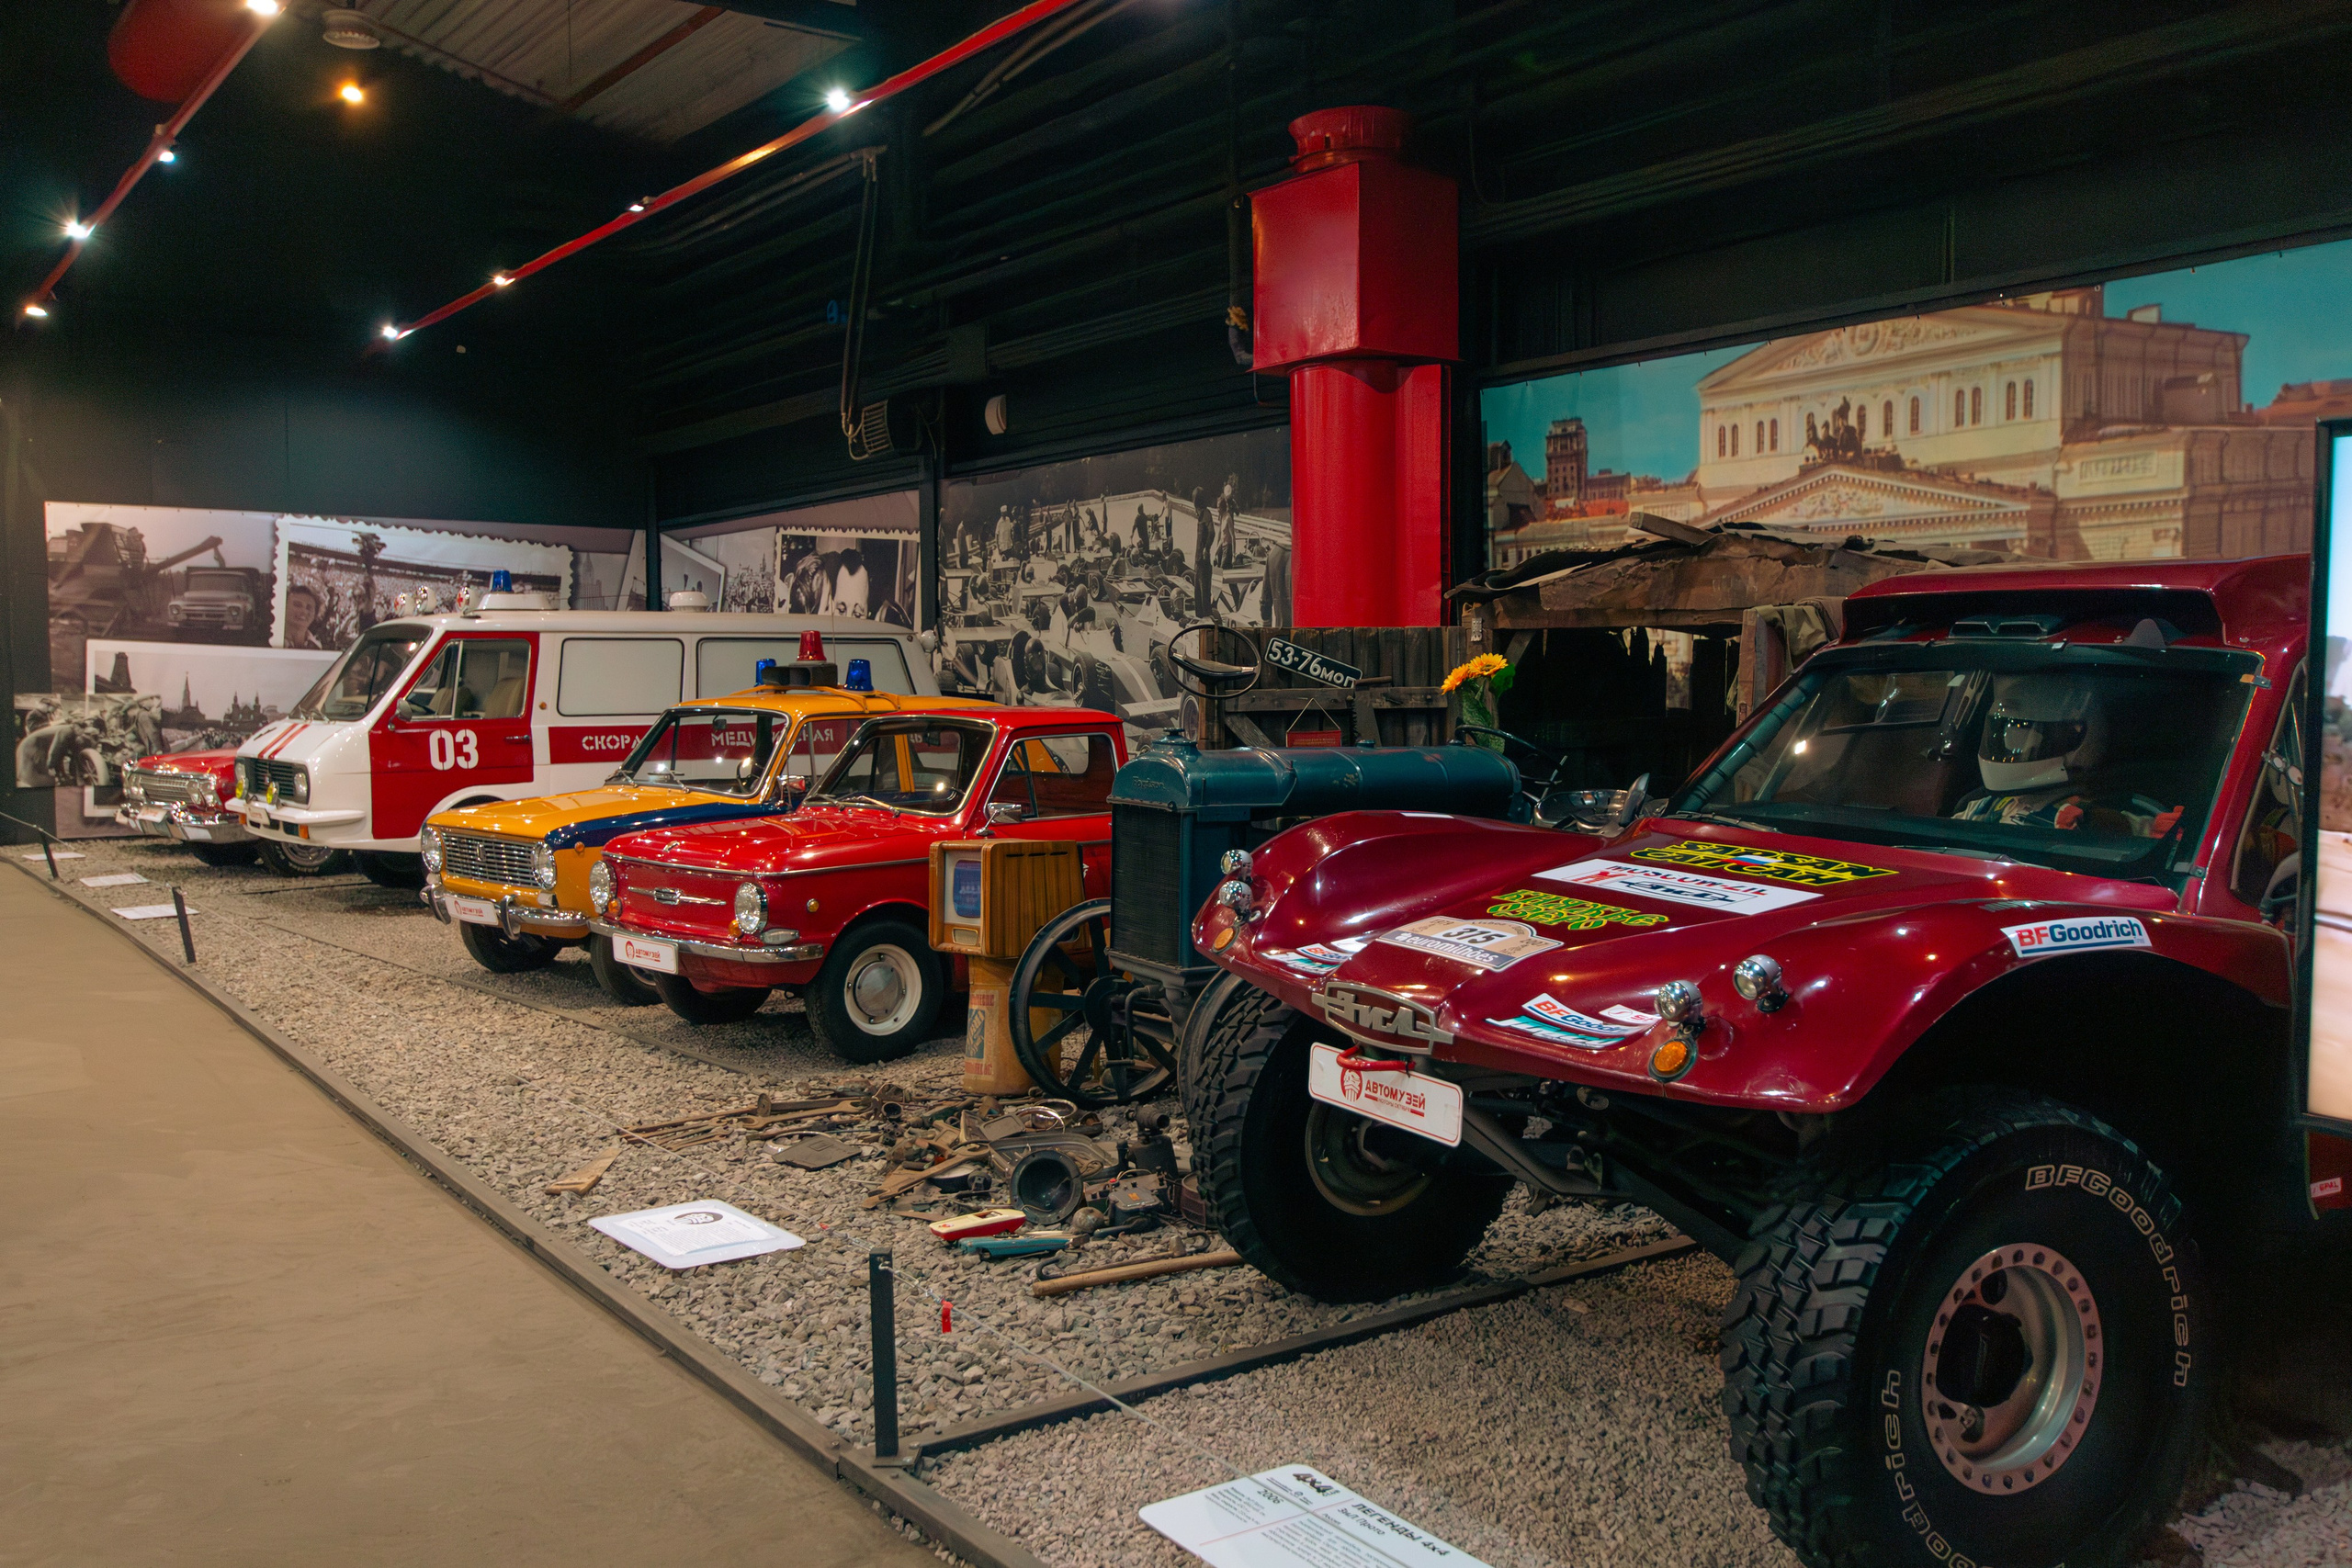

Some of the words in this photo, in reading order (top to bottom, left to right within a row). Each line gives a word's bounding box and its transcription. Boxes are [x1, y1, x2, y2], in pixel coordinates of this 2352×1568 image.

[428, 728, 480, 771] 03
[581, 734, 642, 750] СКОРА
[1442, 927, 1508, 944] 315
[2016, 919, 2143, 947] BFGoodrich
[1407, 935, 1499, 963] euromilhões
[1364, 1078, 1426, 1111] АВТОМУЗЕЙ
[2024, 1163, 2192, 1388] BFGoodrich
[1881, 1369, 1984, 1568] oodrich
[1256, 1487, 1284, 1505] 2006
[1351, 1502, 1422, 1542] ЛЕГЕНДЫ
[1356, 1517, 1386, 1537] Прото
